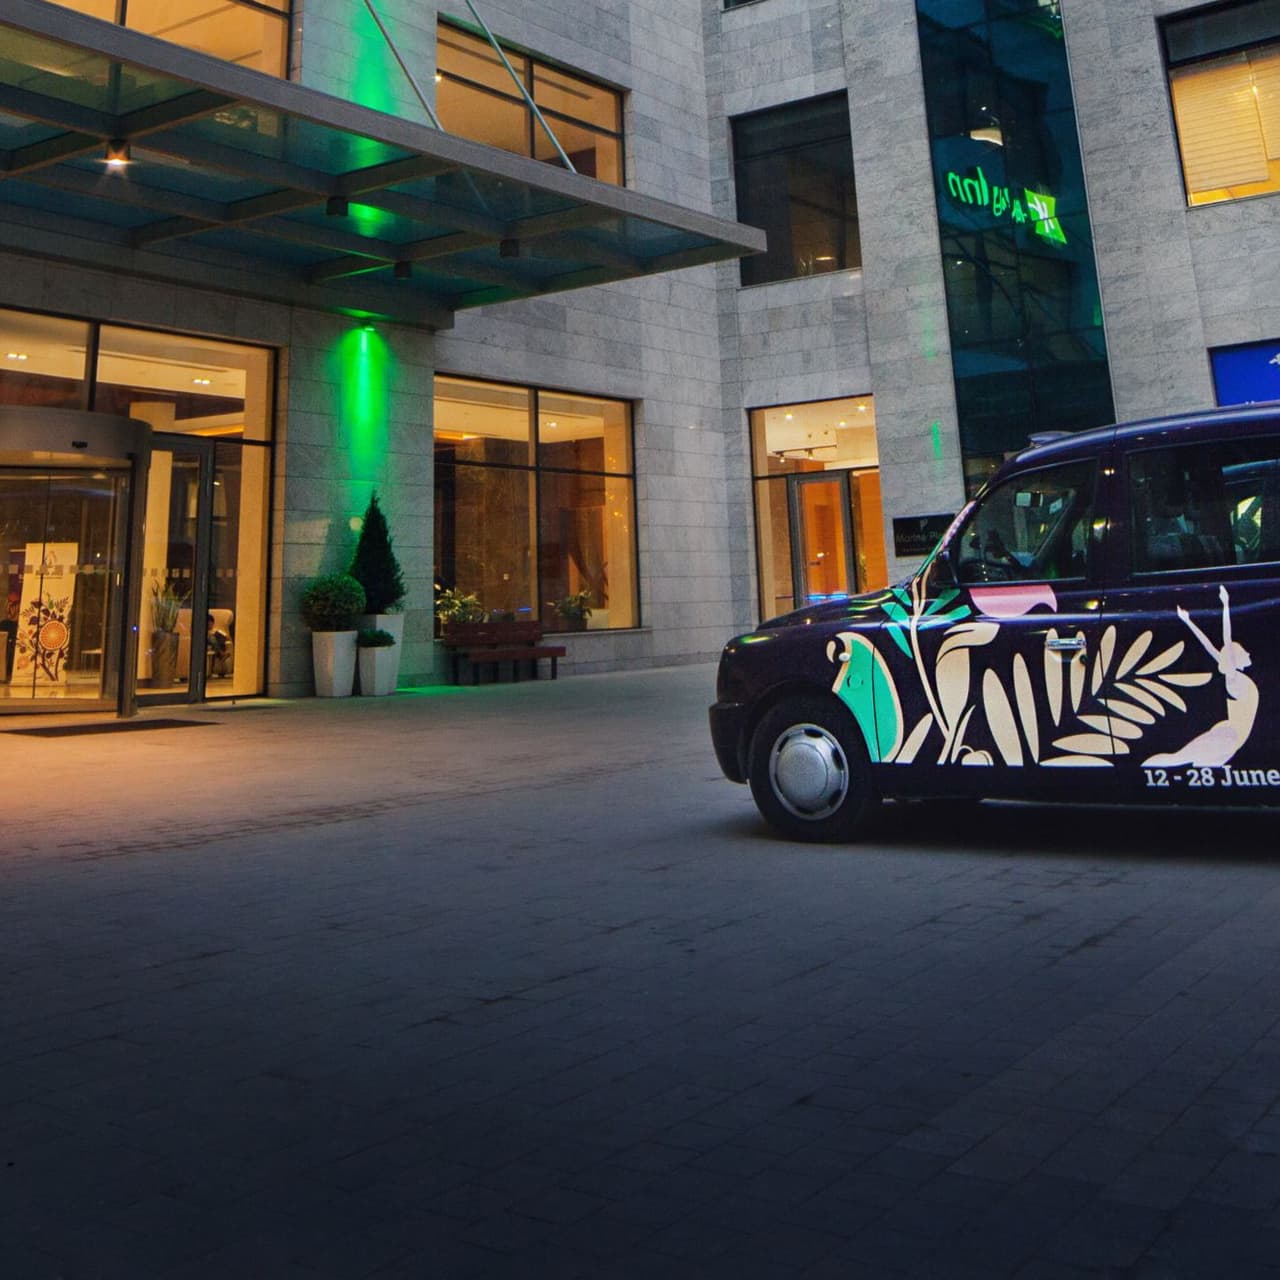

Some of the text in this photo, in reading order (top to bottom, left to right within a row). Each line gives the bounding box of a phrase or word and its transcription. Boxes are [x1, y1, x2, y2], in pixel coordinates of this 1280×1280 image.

[1144, 768, 1170, 787] 12
[1186, 767, 1215, 787] 28
[1220, 764, 1280, 787] June
